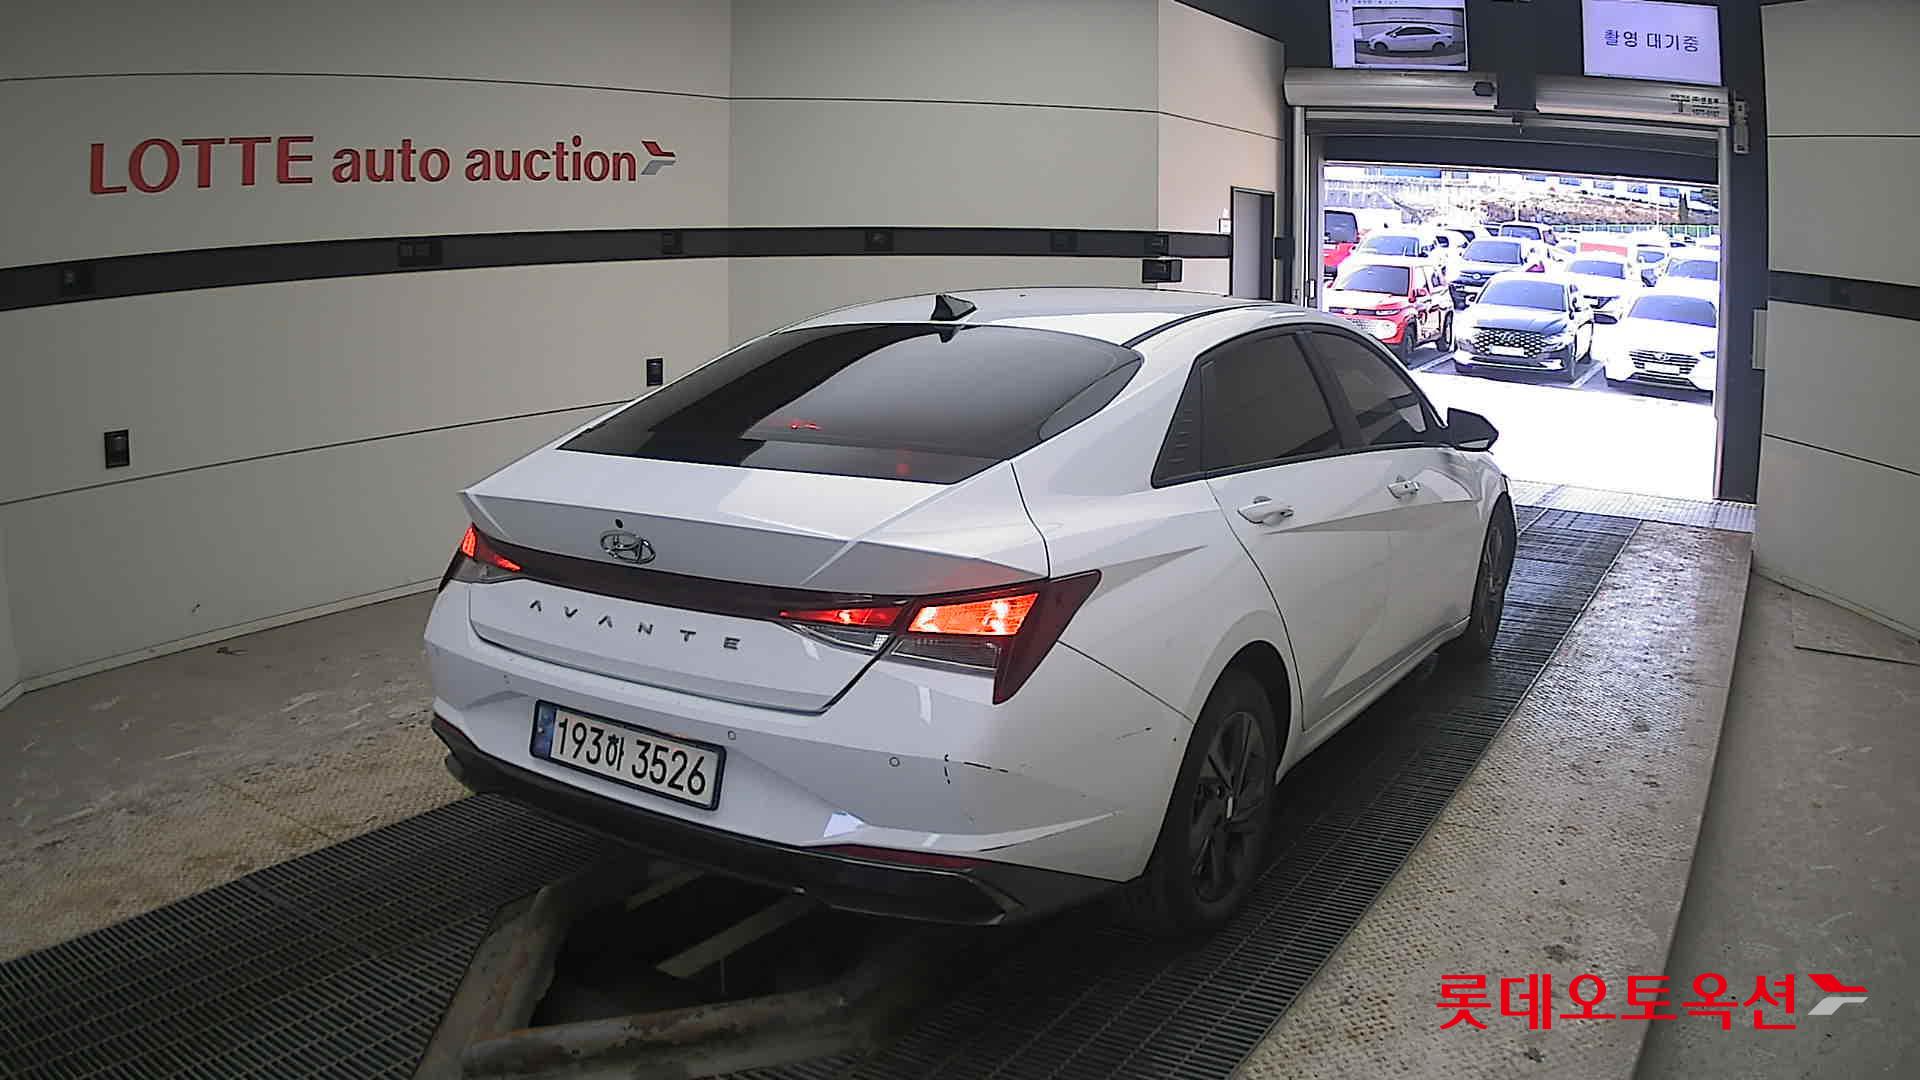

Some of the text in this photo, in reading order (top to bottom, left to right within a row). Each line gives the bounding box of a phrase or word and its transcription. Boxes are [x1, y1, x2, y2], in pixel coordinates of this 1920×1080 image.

[1604, 29, 1700, 53] 촬영 대기중
[89, 134, 638, 195] LOTTE auto auction
[527, 599, 743, 651] AVANTE
[555, 716, 709, 798] 193하 3526
